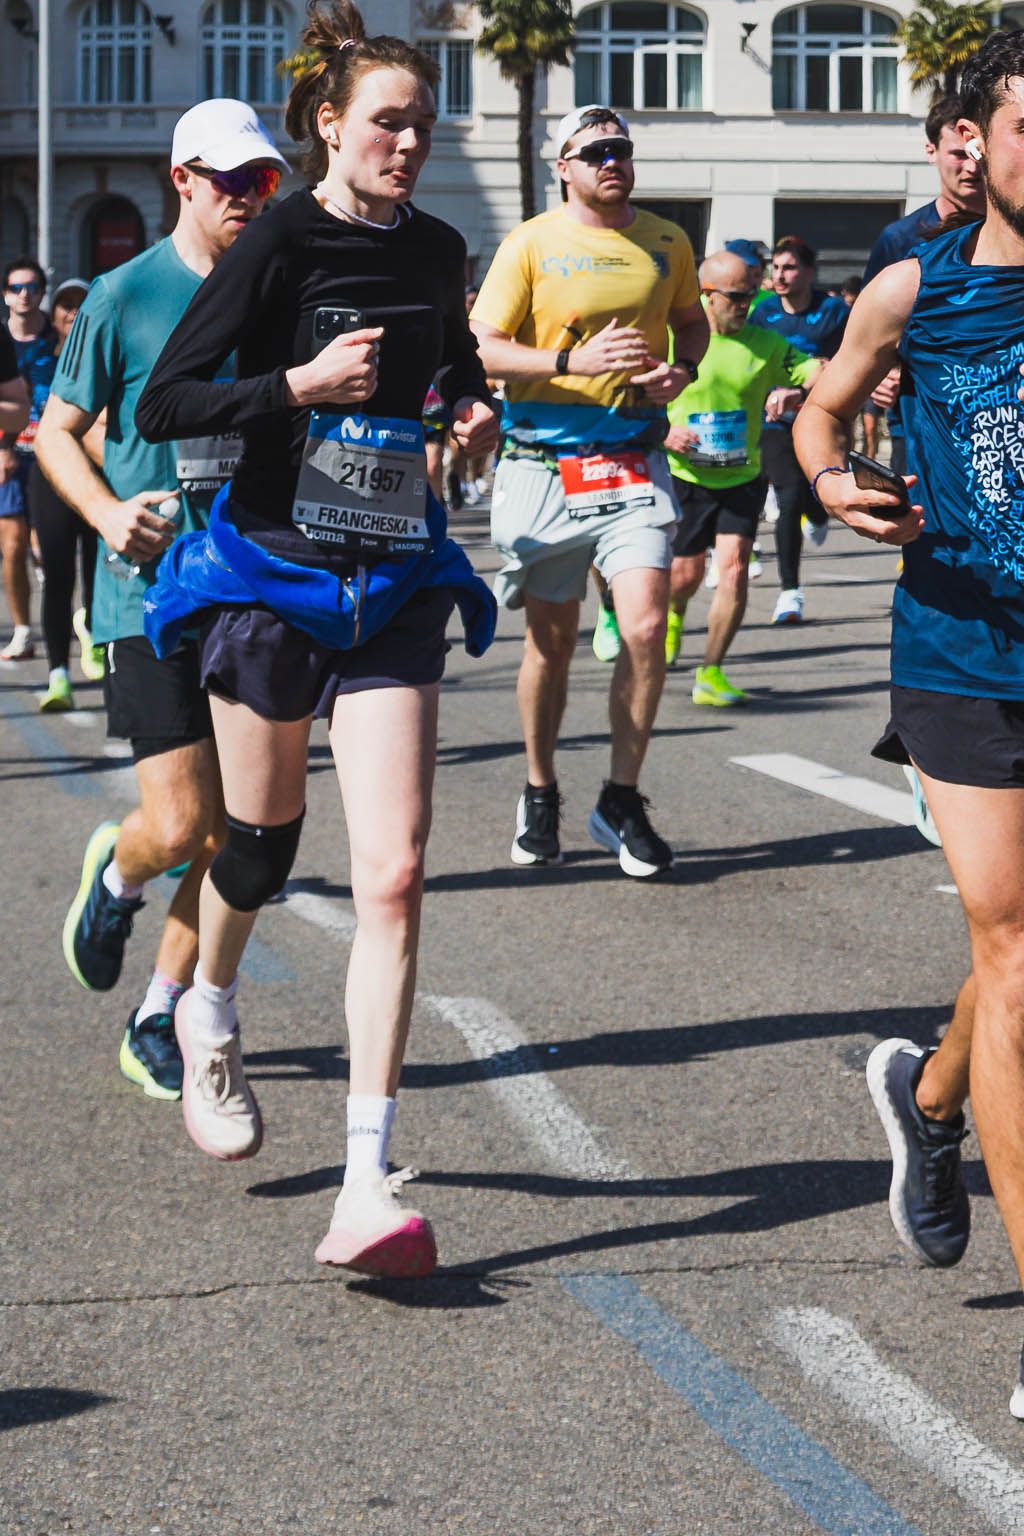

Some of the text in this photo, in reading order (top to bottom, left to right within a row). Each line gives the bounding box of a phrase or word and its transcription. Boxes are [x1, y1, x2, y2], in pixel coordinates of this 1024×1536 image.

[378, 428, 417, 443] movistar
[339, 463, 406, 493] 21957
[317, 506, 409, 535] FRANCHESKA
